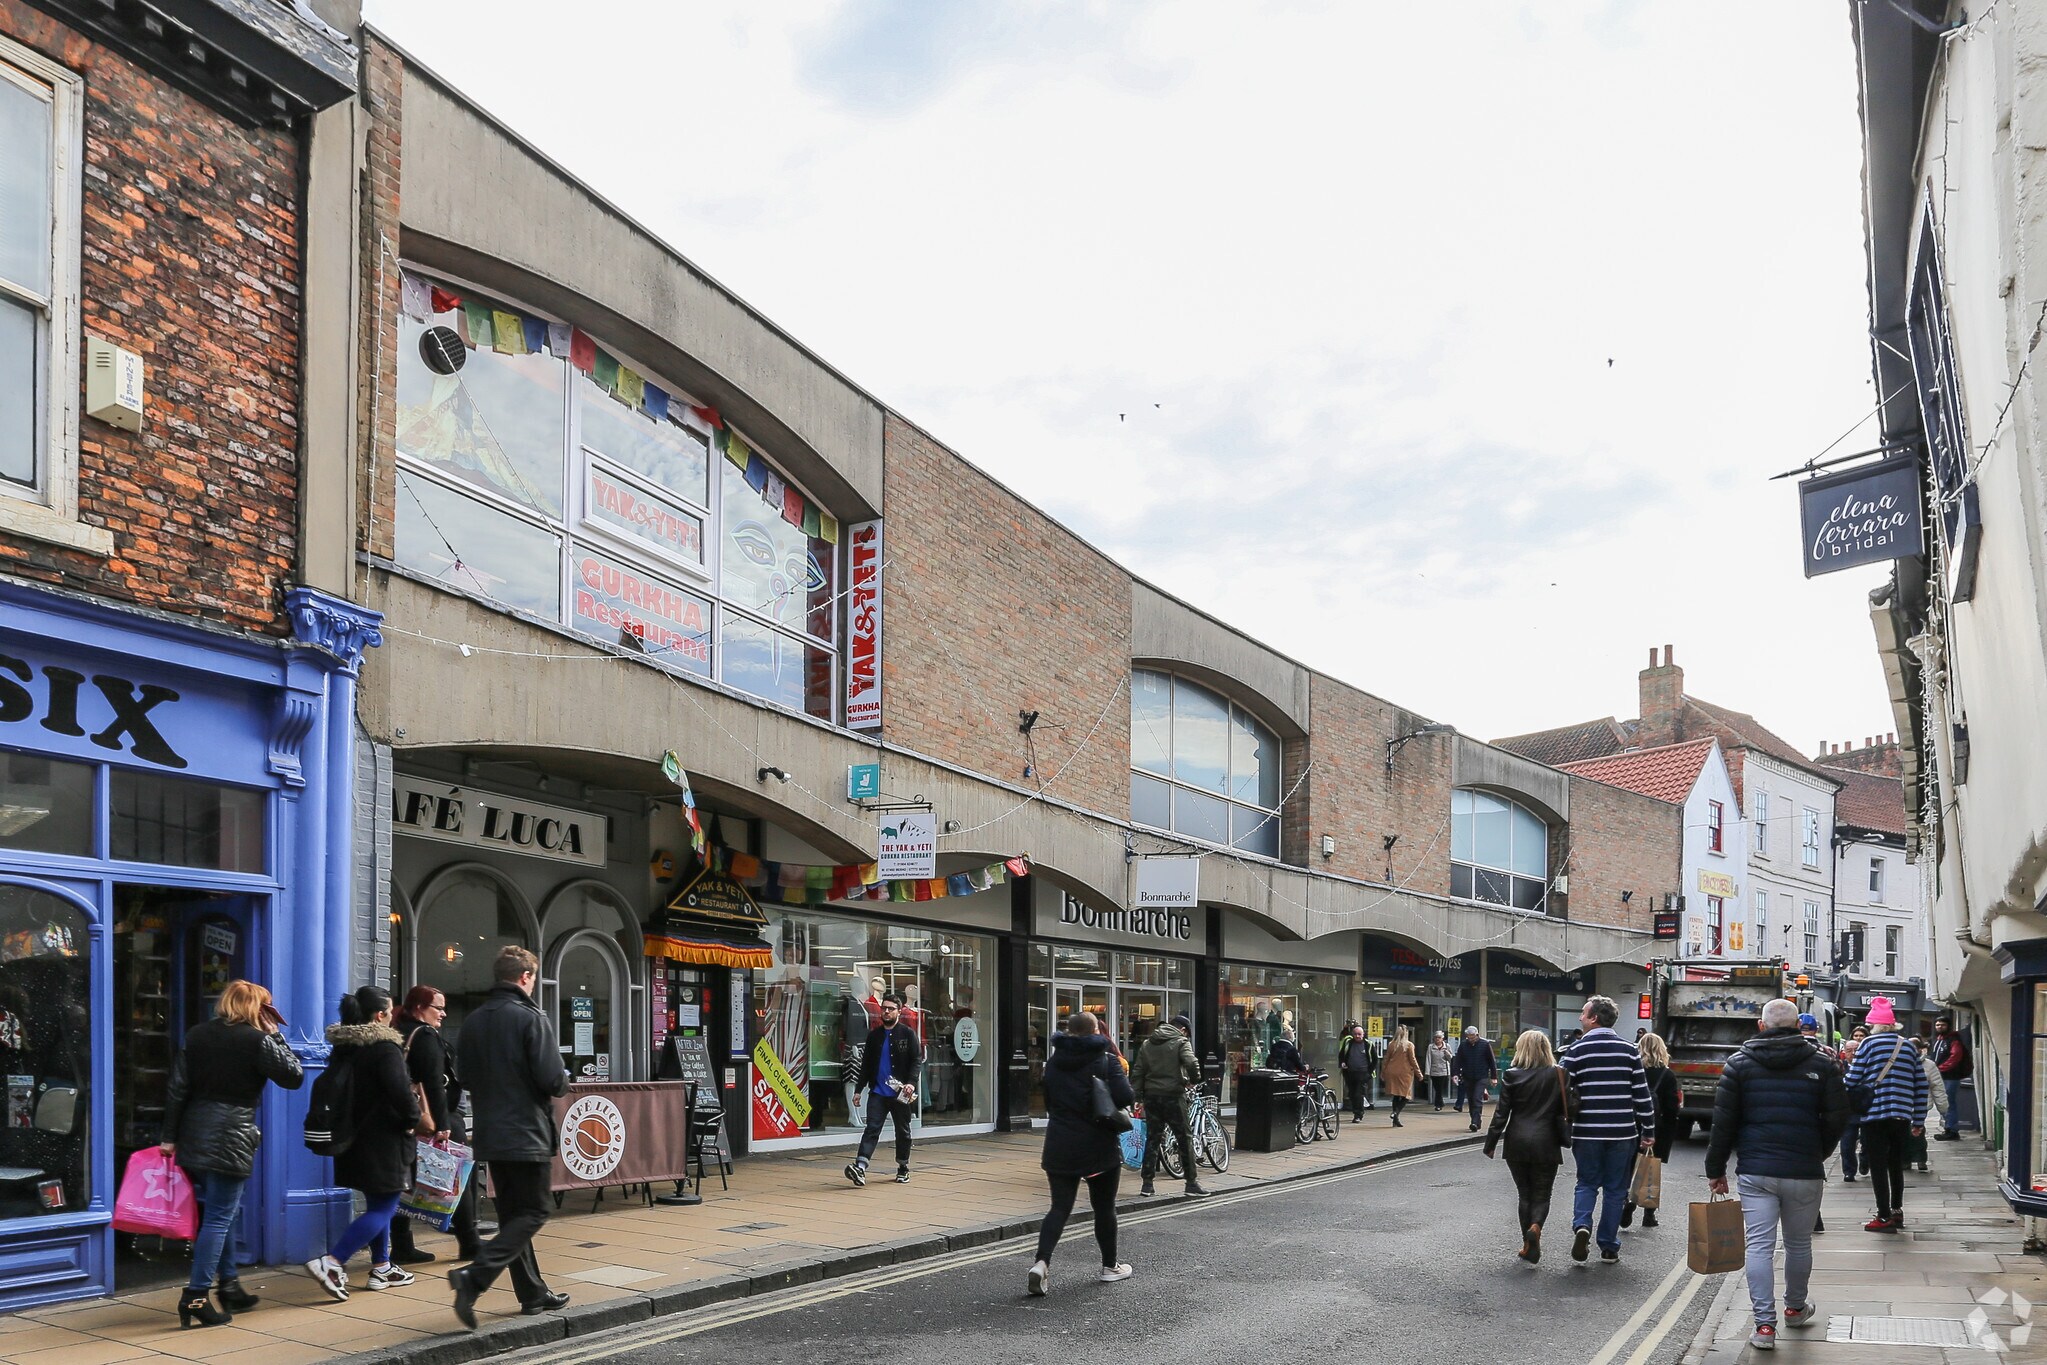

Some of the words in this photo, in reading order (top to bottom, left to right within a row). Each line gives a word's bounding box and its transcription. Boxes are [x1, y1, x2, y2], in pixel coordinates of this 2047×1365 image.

[1830, 494, 1899, 523] elena
[1813, 511, 1911, 560] ferrara
[1831, 530, 1894, 556] bridal
[580, 556, 704, 632] GURKHA
[576, 589, 708, 662] Restaurant
[0, 654, 188, 769] SIX
[847, 701, 880, 714] GURKHA
[848, 713, 880, 723] Restaurant
[480, 805, 585, 855] LUCA
[882, 844, 894, 852] THE
[896, 844, 909, 852] YAK
[917, 843, 932, 851] YETI
[696, 881, 715, 894] YAK
[716, 881, 723, 892] &
[724, 882, 744, 902] YETI
[1141, 891, 1191, 902] Bonmarché
[700, 899, 740, 911] RESTAURANT
[207, 934, 232, 952] OPEN
[1505, 963, 1522, 976] Open
[1522, 967, 1538, 979] every
[573, 1010, 592, 1018] OPEN
[814, 1024, 834, 1037] NEW
[677, 1039, 692, 1050] AFTER
[687, 1053, 696, 1061] Tea
[756, 1046, 773, 1072] FINAL
[773, 1069, 807, 1118] CLEARANCE
[753, 1079, 791, 1132] SALE
[566, 1100, 592, 1133] CAFÉ
[595, 1101, 621, 1131] LUCA
[566, 1150, 595, 1175] CAFÉ
[596, 1147, 620, 1175] LUCA
